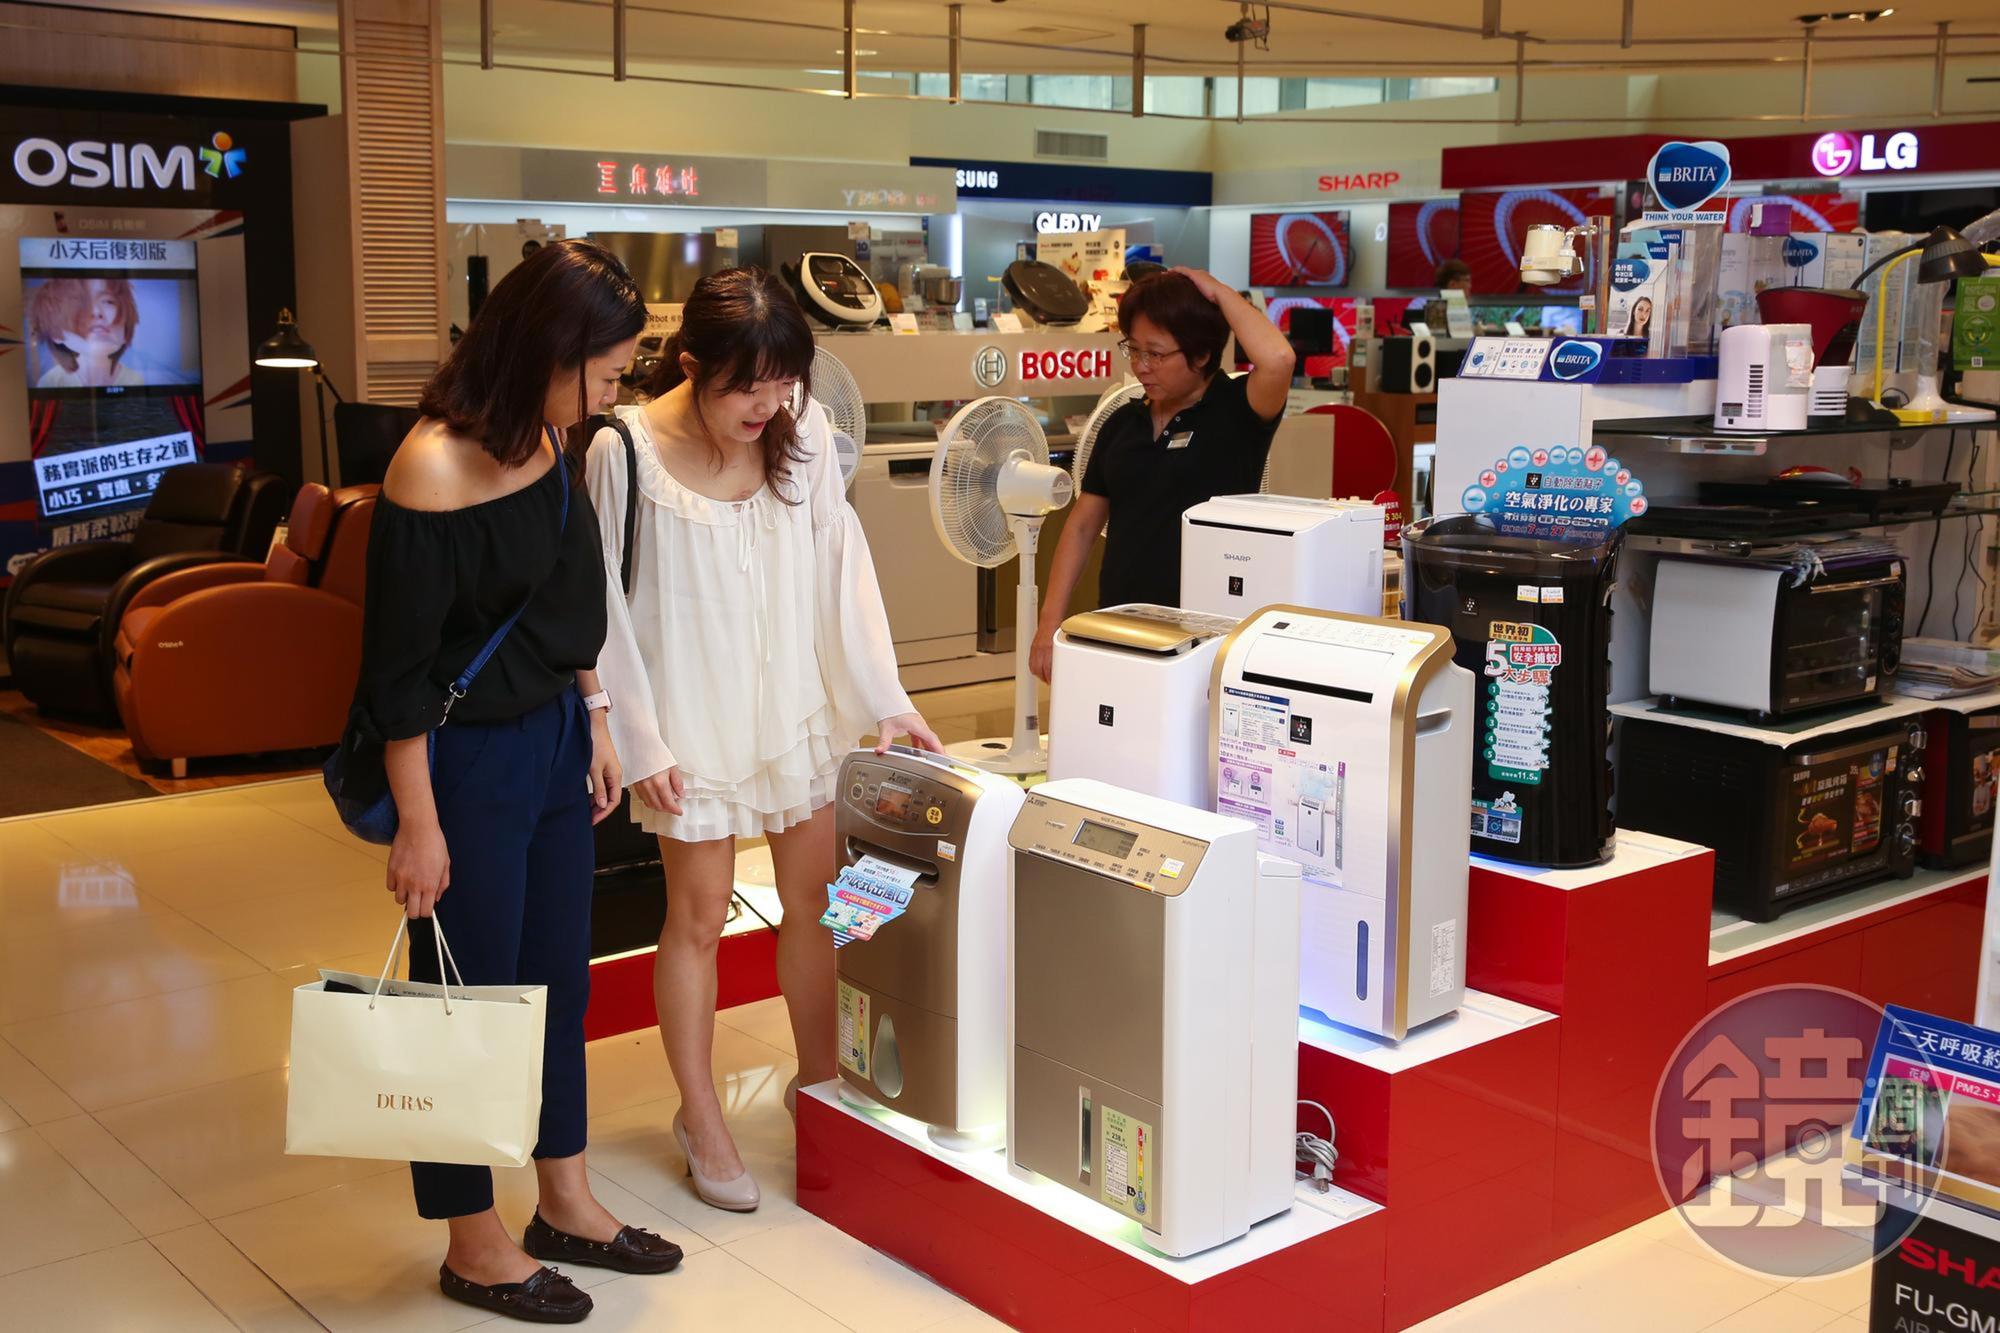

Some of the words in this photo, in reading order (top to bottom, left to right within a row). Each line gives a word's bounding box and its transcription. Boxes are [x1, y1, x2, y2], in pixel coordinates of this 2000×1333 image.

[1860, 131, 1919, 171] LG
[13, 137, 197, 191] OSIM
[1672, 166, 1717, 182] BRITA
[955, 169, 999, 189] SUNG
[1317, 171, 1400, 192] SHARP
[1036, 212, 1080, 234] QLED
[1080, 214, 1101, 233] TV
[1644, 213, 1669, 222] THINK
[1671, 213, 1693, 222] YOUR
[1695, 213, 1725, 222] WATER
[49, 240, 167, 261] 小天后復刻版
[1019, 350, 1112, 380] BOSCH
[1564, 354, 1592, 365] BRITA
[43, 439, 190, 483] 務實派的生存之道
[1504, 491, 1614, 513] 空氣淨化の專家
[1223, 553, 1251, 562] SHARP
[1493, 623, 1530, 637] 世界初
[1484, 640, 1508, 677] 5
[1513, 652, 1558, 664] 安全捕蚊
[839, 872, 909, 905] 下吹式出風口
[1898, 1030, 2000, 1070] 一天呼吸約
[376, 1093, 434, 1112] DURAS
[1898, 1236, 2000, 1291] SHA
[1895, 1283, 2000, 1333] FU-GM
